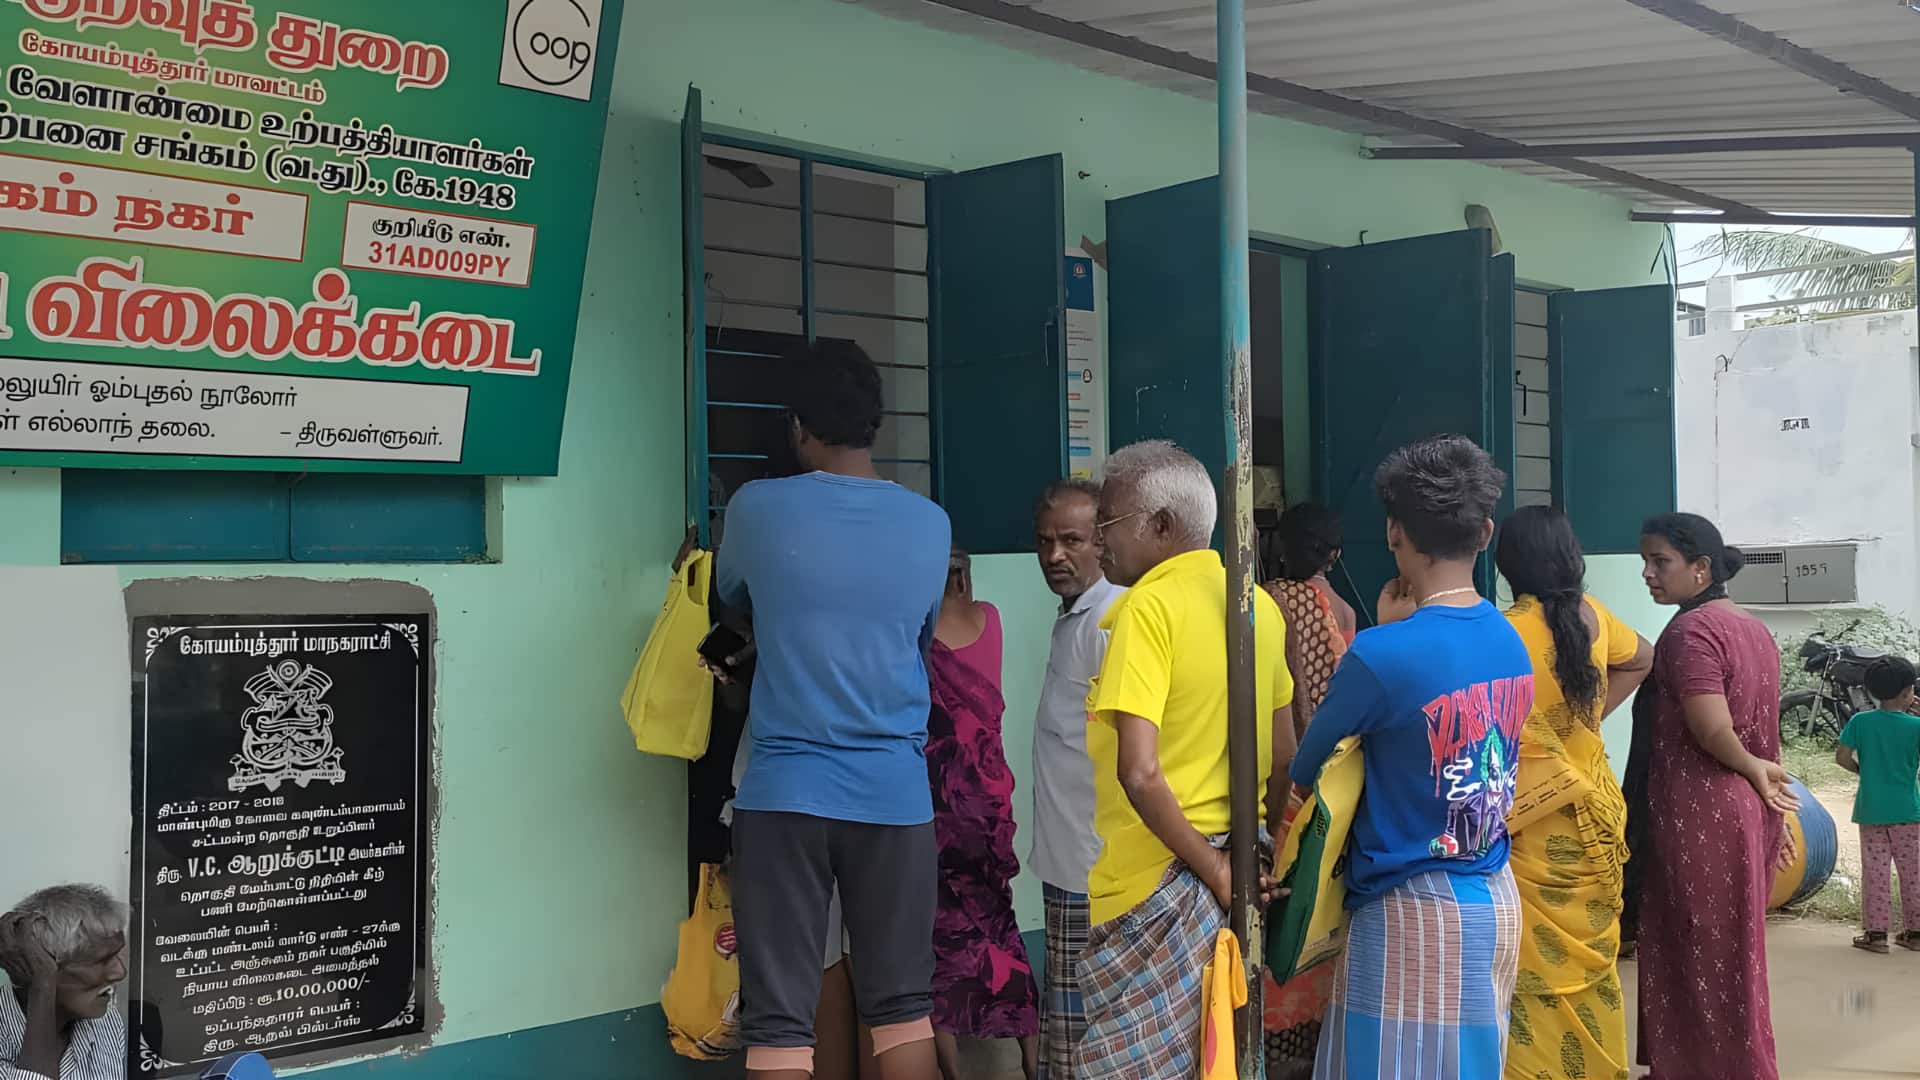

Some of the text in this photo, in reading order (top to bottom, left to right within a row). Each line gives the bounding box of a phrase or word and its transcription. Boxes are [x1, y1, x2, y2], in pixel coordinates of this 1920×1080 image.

[22, 31, 325, 102] கோயம்புத்தூர் மாவட்டம்
[268, 15, 447, 87] துறை
[9, 67, 533, 177] வேளாண்மை உற்பத்தியாளர்கள்
[134, 131, 256, 169] சங்கம்
[113, 193, 254, 236] நகர்
[371, 217, 511, 248] குறியீடு எண்.
[368, 241, 511, 278] 31AD009PY
[31, 262, 538, 372] விலைக்கடை
[89, 376, 193, 407] ஓம்புதல்
[200, 385, 298, 410] நூலோர்
[28, 409, 132, 443] எல்லாந்
[138, 420, 216, 443] தலை.
[295, 421, 443, 449] திருவள்ளுவர்.
[180, 630, 392, 657] கோயம்புத்தூர் மாநகராட்சி
[157, 800, 198, 819] திட்டம்
[208, 800, 240, 812] 2017
[253, 796, 285, 808] 2018
[192, 831, 255, 848] சட்டமன்ற
[188, 856, 222, 879] V.C.
[227, 845, 346, 877] ஆறுக்குட்டி
[235, 920, 270, 936] பெயர்
